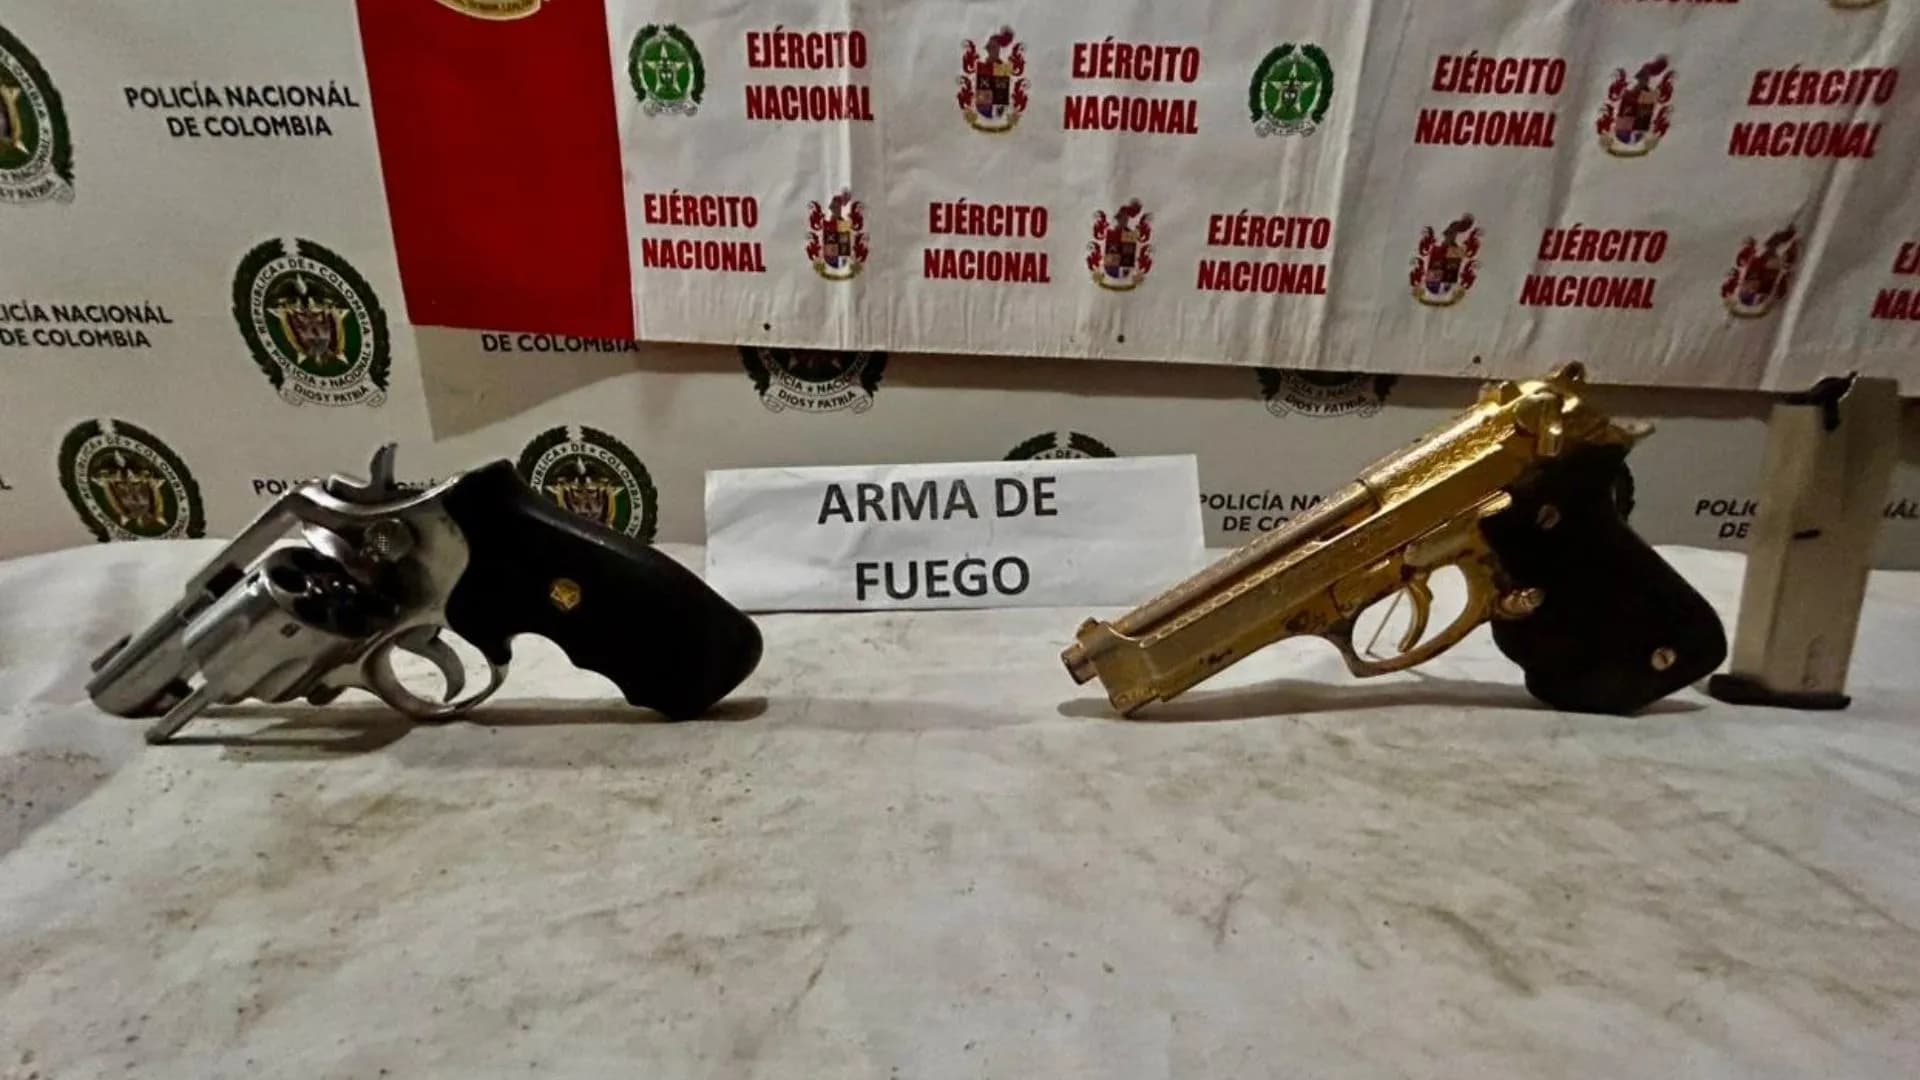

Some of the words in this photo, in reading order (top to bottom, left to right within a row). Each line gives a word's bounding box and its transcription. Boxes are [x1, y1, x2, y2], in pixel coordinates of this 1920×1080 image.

[746, 25, 868, 70] EJÉRCITO
[1071, 35, 1201, 84] EJÉRCITO
[1431, 49, 1567, 96] EJÉRCITO
[1747, 63, 1899, 107] EJÉRCITO
[123, 79, 223, 109] POLICÍA
[744, 84, 876, 122] NACIONAL
[1063, 94, 1199, 135] NACIONAL
[166, 115, 200, 137] DE
[203, 115, 334, 137] COLOMBIA
[1413, 108, 1558, 149] NACIONAL
[1727, 121, 1883, 159] NACIONAL
[643, 187, 759, 229] EJÉRCITO
[929, 197, 1048, 239] EJÉRCITO
[1207, 208, 1332, 250] EJÉRCITO
[1537, 222, 1669, 264] EJÉRCITO
[641, 238, 767, 273] NACIONAL
[923, 248, 1051, 284] NACIONAL
[1196, 259, 1328, 296] NACIONAL
[1519, 274, 1657, 310] NACIONAL
[318, 266, 371, 336] COLOMBIA
[0, 327, 30, 347] DE
[32, 328, 153, 349] COLOMBIA
[481, 333, 513, 352] DE
[517, 334, 641, 353] COLOMBIA
[817, 390, 858, 410] PATRIA
[599, 449, 641, 510] COLOMBIA
[817, 479, 979, 525] ARMA
[994, 476, 1058, 518] DE
[1222, 515, 1252, 532] DE
[1718, 521, 1752, 539] DE
[855, 555, 1030, 601] FUEGO
